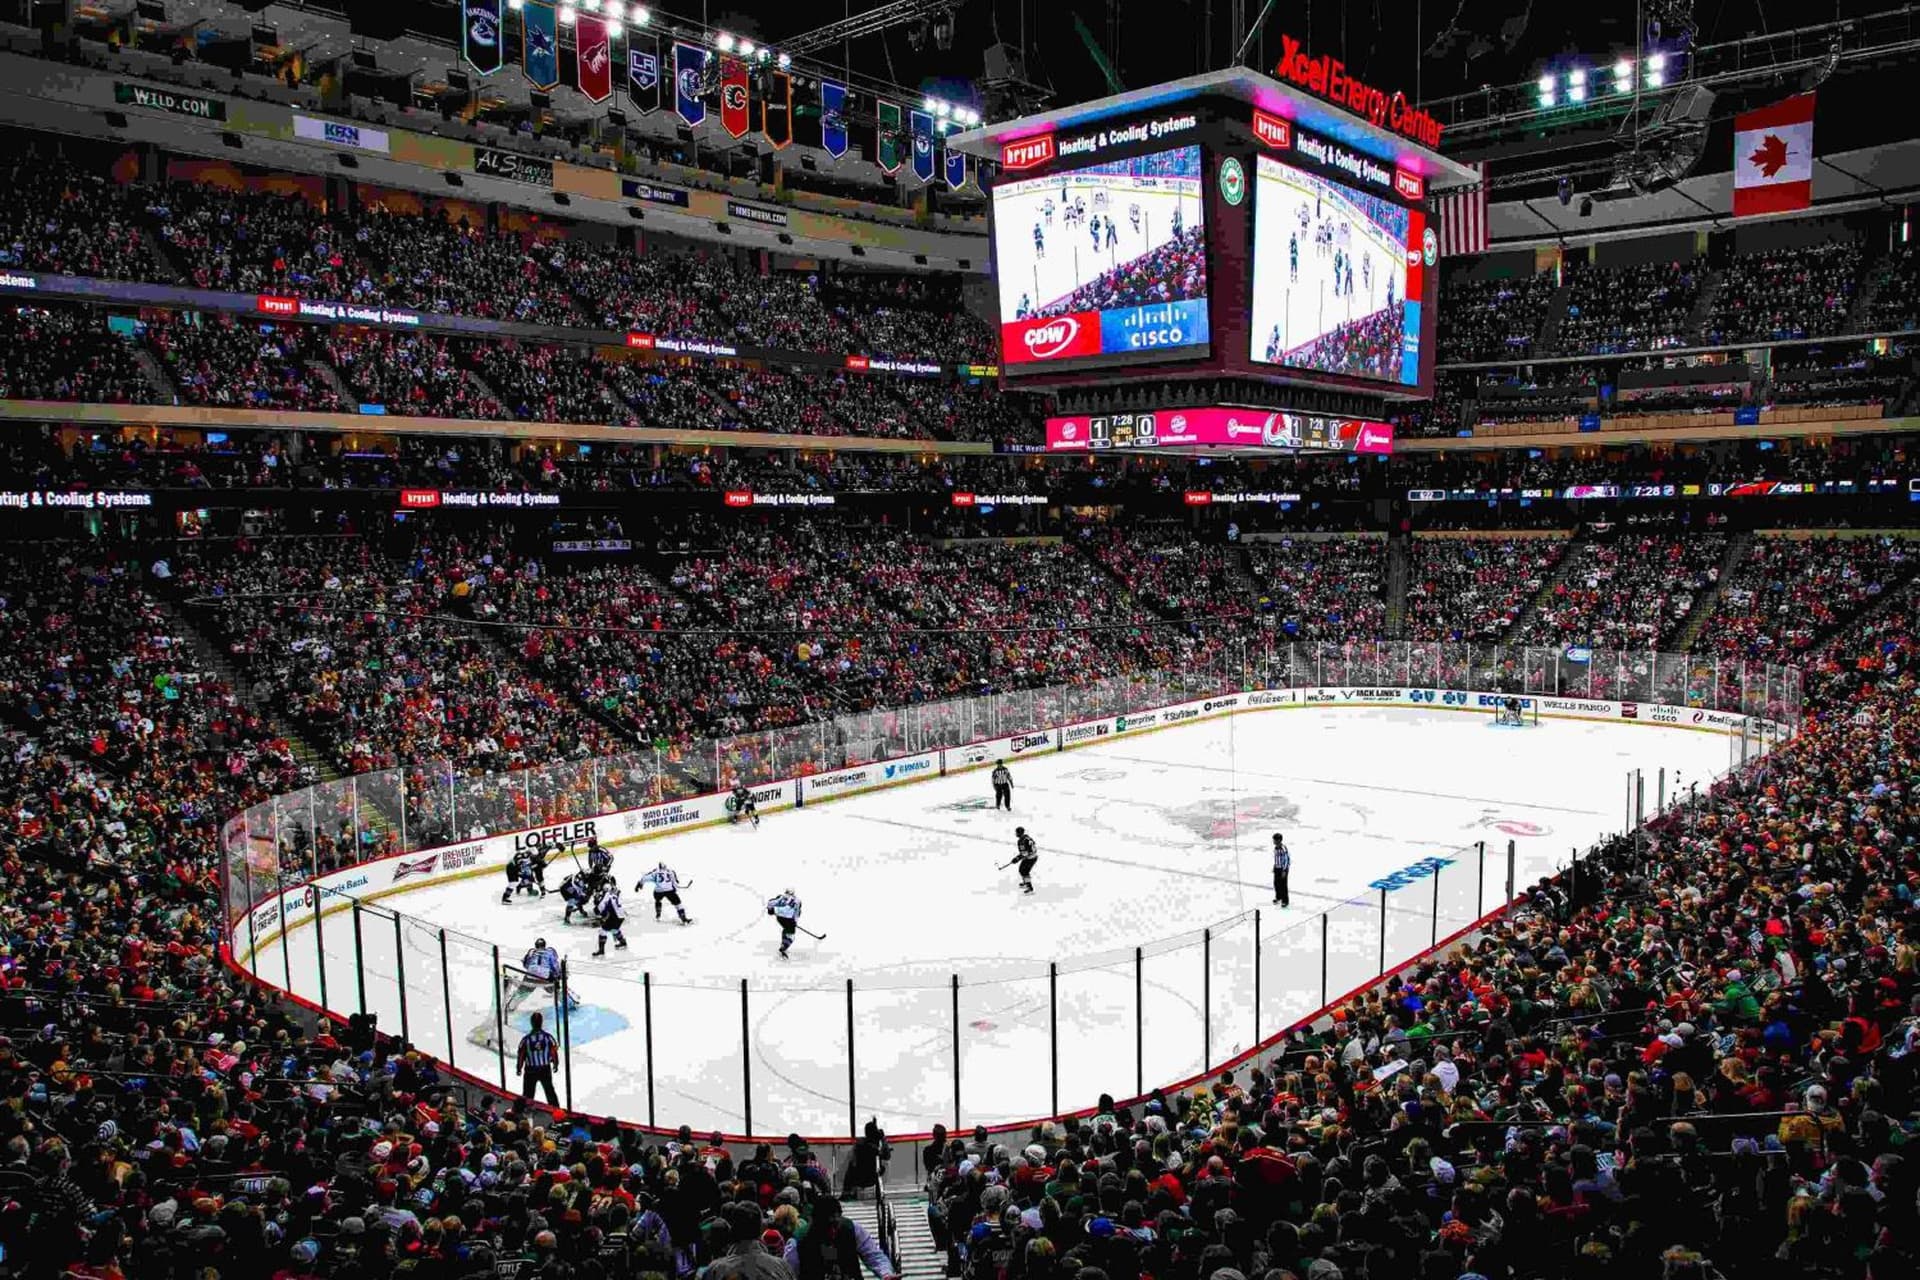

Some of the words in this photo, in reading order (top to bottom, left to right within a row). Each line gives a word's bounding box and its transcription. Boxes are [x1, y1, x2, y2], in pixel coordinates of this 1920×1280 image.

[1278, 34, 1330, 94] Xcel
[1331, 58, 1389, 127] Energy
[1390, 90, 1445, 147] Center
[134, 87, 211, 117] WILD.COM
[1006, 140, 1048, 164] bryant
[1058, 138, 1097, 156] Heating
[1099, 133, 1107, 147] &
[1109, 126, 1149, 146] Cooling
[1150, 115, 1196, 136] Systems
[1257, 117, 1286, 144] bryant
[1297, 132, 1327, 164] Heating
[1327, 146, 1335, 164] &
[1335, 149, 1363, 179] Cooling
[1362, 160, 1391, 186] Systems
[1399, 176, 1420, 194] bryant
[300, 302, 337, 319] Heating
[337, 306, 346, 318] &
[347, 307, 381, 323] Cooling
[382, 311, 419, 325] Systems
[1024, 325, 1065, 346] CDW
[1131, 328, 1183, 347] CISCO
[1093, 421, 1103, 439] 1
[1140, 417, 1152, 436] 0
[1112, 414, 1134, 427] 7:28
[1293, 419, 1300, 438] 1
[1331, 422, 1338, 441] 0
[1521, 489, 1542, 498] SOG
[1634, 486, 1660, 497] 7:28
[1711, 484, 1720, 495] 0
[1780, 484, 1802, 493] SOG
[31, 491, 43, 505] &
[46, 491, 95, 508] Cooling
[97, 491, 151, 508] Systems
[442, 492, 478, 506] Heating
[479, 493, 488, 504] &
[489, 492, 523, 506] Cooling
[523, 493, 560, 506] Systems
[1479, 694, 1531, 709] ECOB
[1543, 700, 1576, 711] WELLS
[1578, 703, 1611, 713] FARGO
[1652, 714, 1677, 722] CISCO
[1706, 714, 1725, 724] Xcel
[752, 787, 782, 804] NORTH
[642, 809, 662, 820] MAYO
[662, 805, 684, 817] CLINIC
[642, 816, 668, 830] SPORTS
[515, 821, 597, 851] LOFFLER
[346, 876, 369, 890] Bank
